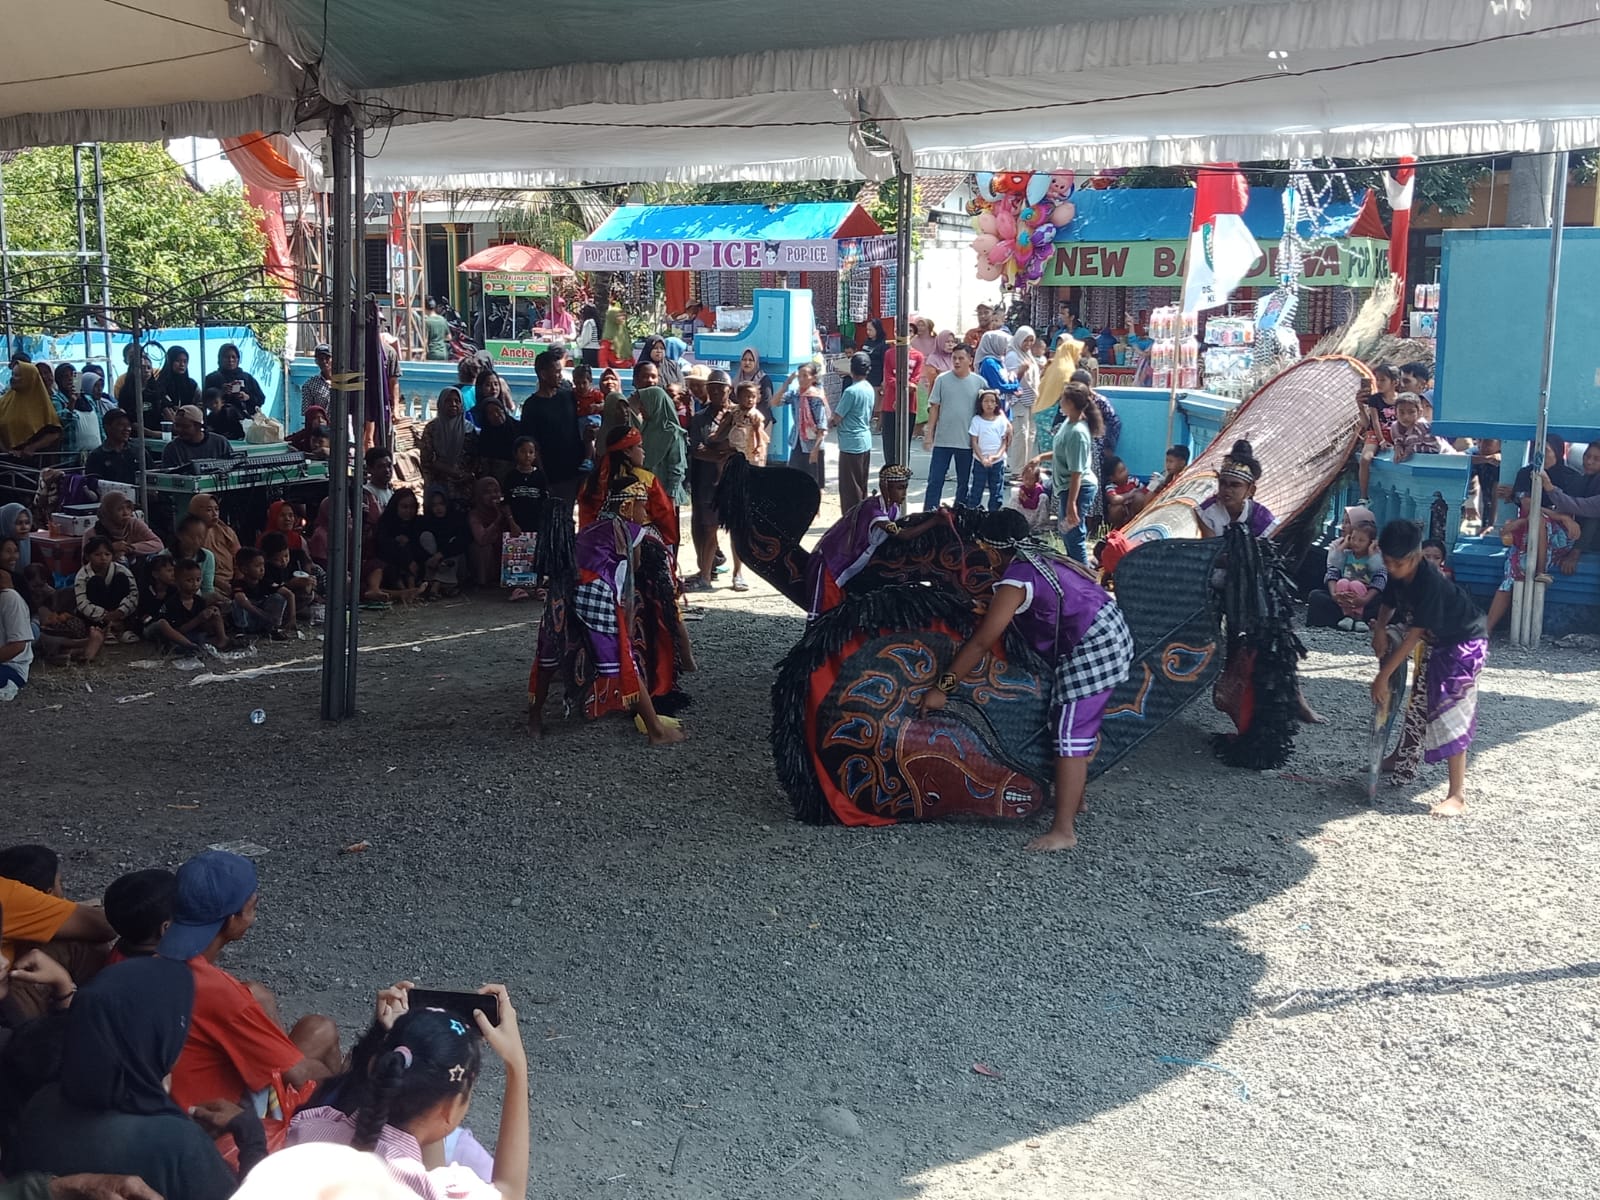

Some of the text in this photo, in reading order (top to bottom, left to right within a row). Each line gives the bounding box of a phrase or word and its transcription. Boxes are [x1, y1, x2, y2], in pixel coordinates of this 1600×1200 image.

[585, 248, 622, 262] POP ICE
[640, 242, 761, 268] POP ICE
[787, 247, 827, 262] POP ICE
[1054, 246, 1130, 278] NEW
[1348, 246, 1371, 279] POP
[500, 346, 535, 359] Aneka
